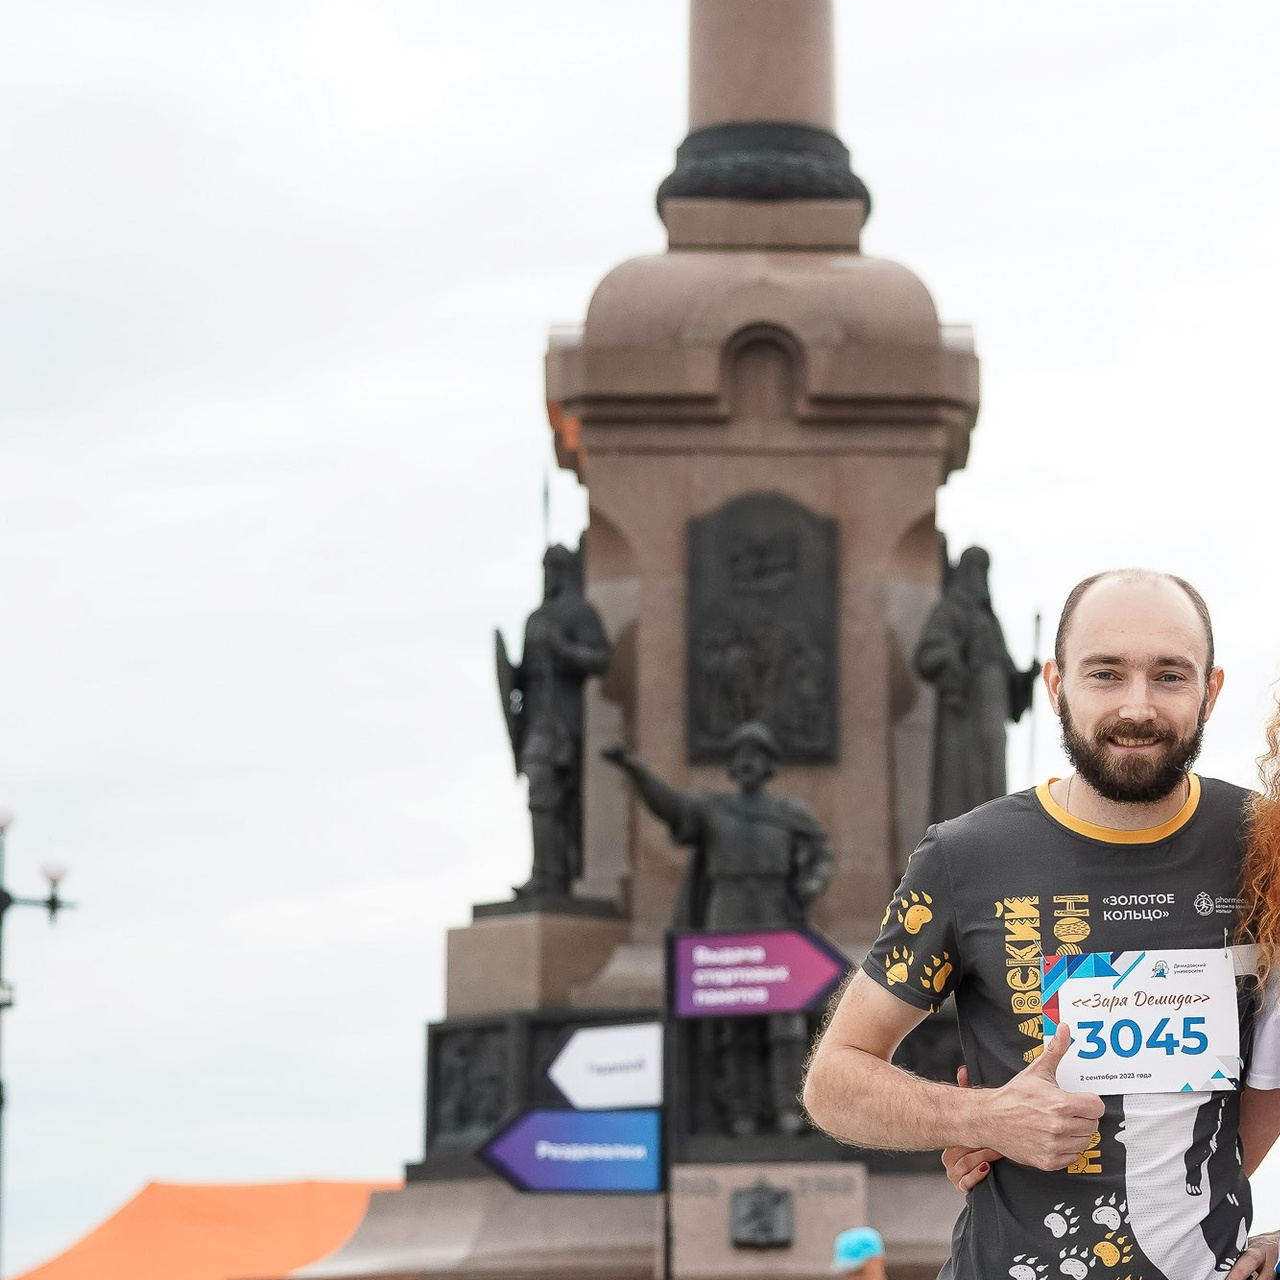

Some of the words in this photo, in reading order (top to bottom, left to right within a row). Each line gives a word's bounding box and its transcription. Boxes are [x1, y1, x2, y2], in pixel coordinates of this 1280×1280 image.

[1102, 893, 1175, 906] «ЗОЛОТОЕ
[1103, 909, 1170, 922] КОЛЬЦО»
[1077, 1016, 1209, 1060] 3045
[1085, 1073, 1118, 1082] сентября
[1119, 1072, 1135, 1080] 2023
[1136, 1072, 1152, 1080] года
